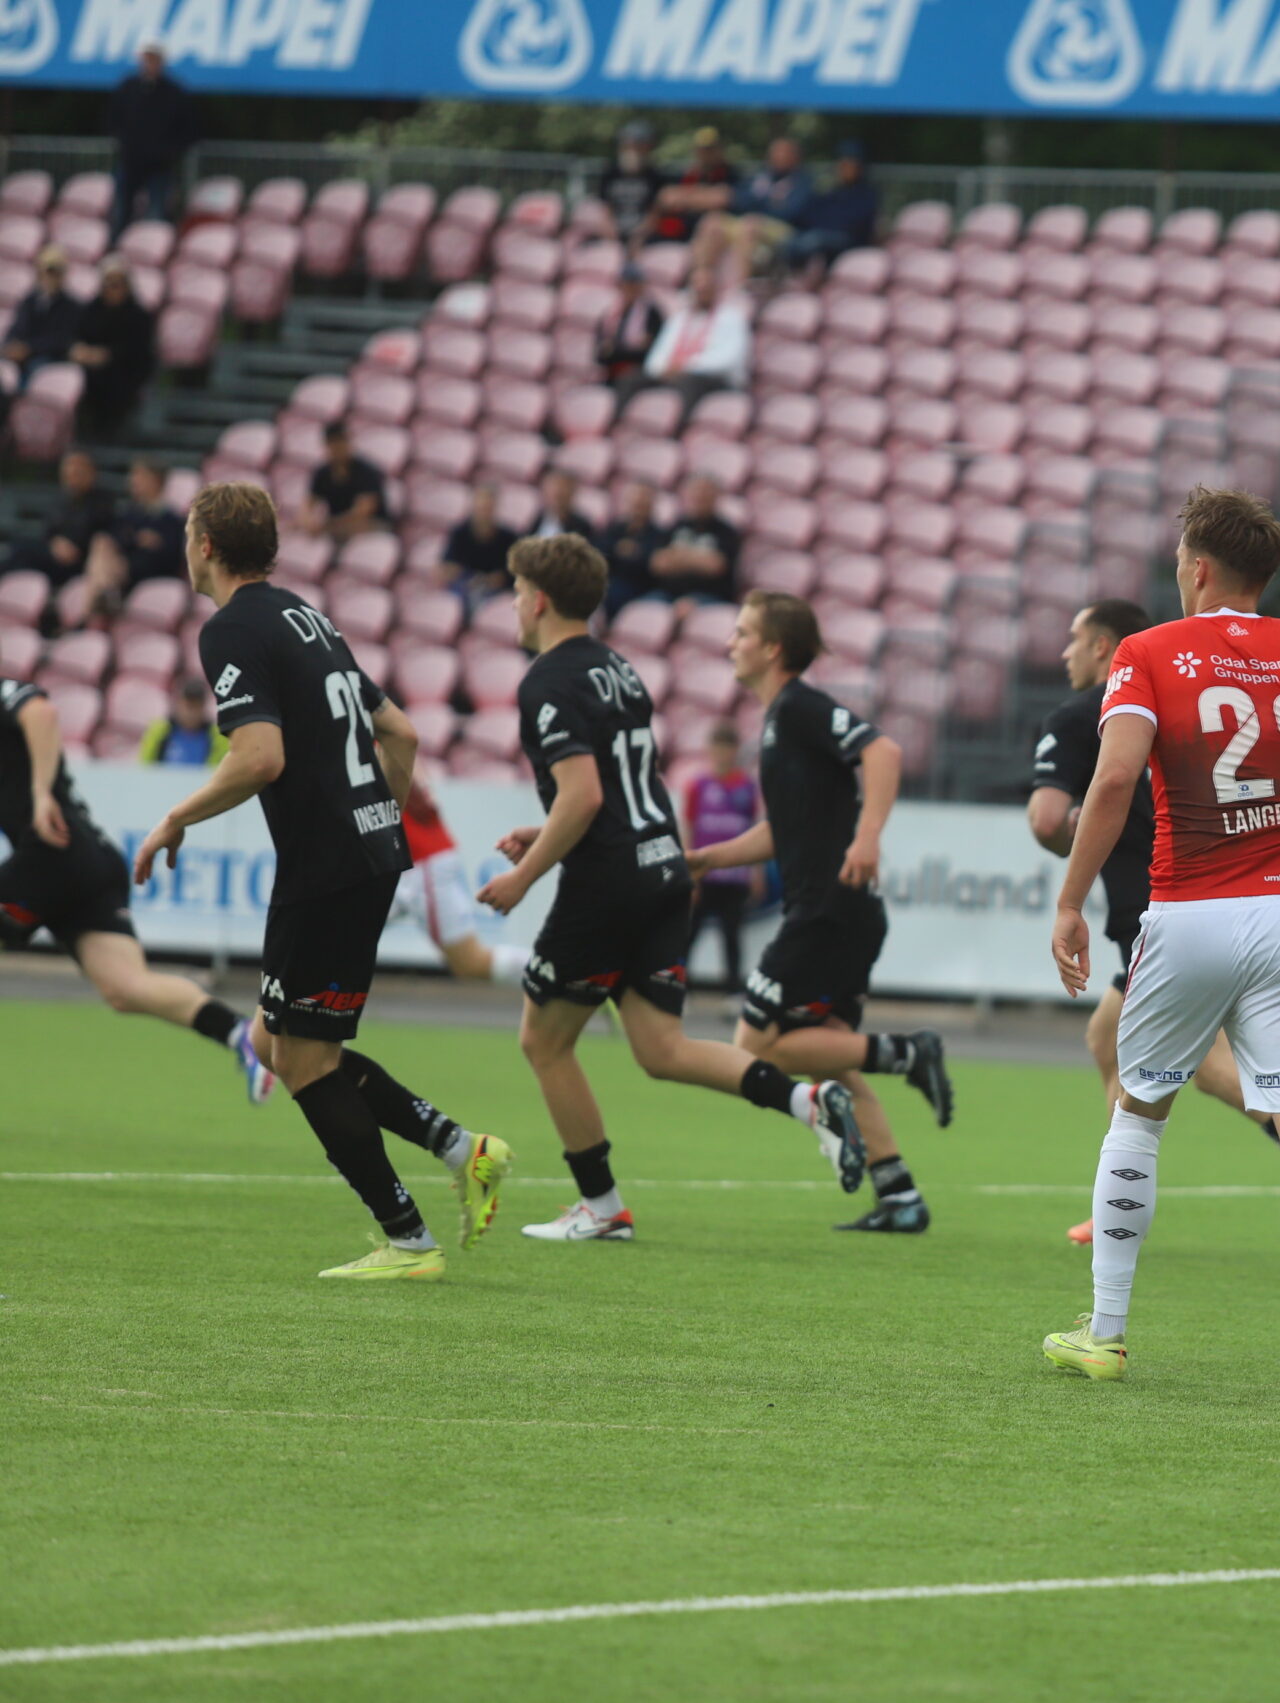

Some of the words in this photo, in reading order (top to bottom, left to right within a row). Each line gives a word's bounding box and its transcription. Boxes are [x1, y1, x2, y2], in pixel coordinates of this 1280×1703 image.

[70, 0, 376, 71] MAPEI
[602, 0, 932, 85] MAPEI
[281, 605, 342, 651] DN
[1210, 654, 1248, 669] Odal
[1214, 666, 1280, 684] Gruppen
[612, 727, 667, 831] 17
[884, 855, 1051, 907] ulland
